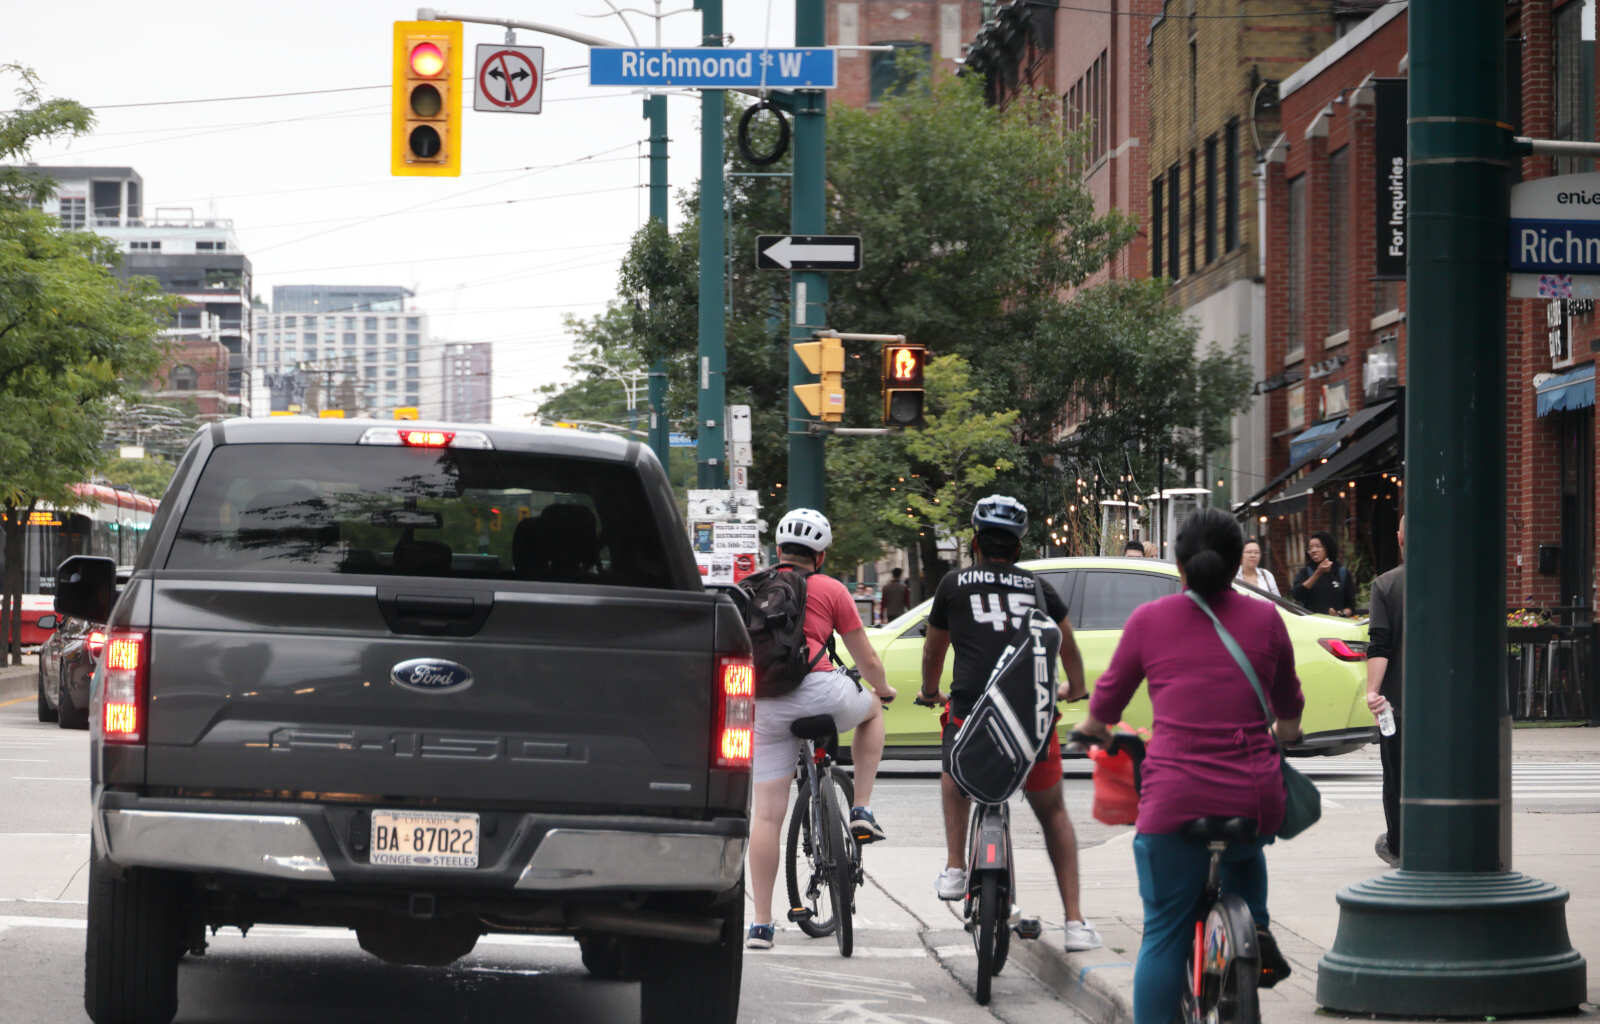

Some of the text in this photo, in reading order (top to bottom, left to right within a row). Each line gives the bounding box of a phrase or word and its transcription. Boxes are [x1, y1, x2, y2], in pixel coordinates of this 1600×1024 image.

[622, 51, 803, 78] Richmond St W
[1388, 156, 1406, 256] For Inquiries
[957, 570, 1035, 590] KING WES
[969, 592, 1036, 632] 45
[409, 664, 455, 685] Ford
[1030, 627, 1050, 741] HEAD
[404, 817, 447, 825] ONTARIO
[376, 825, 473, 855] BA 87022
[373, 854, 477, 867] YONGE STEELES
